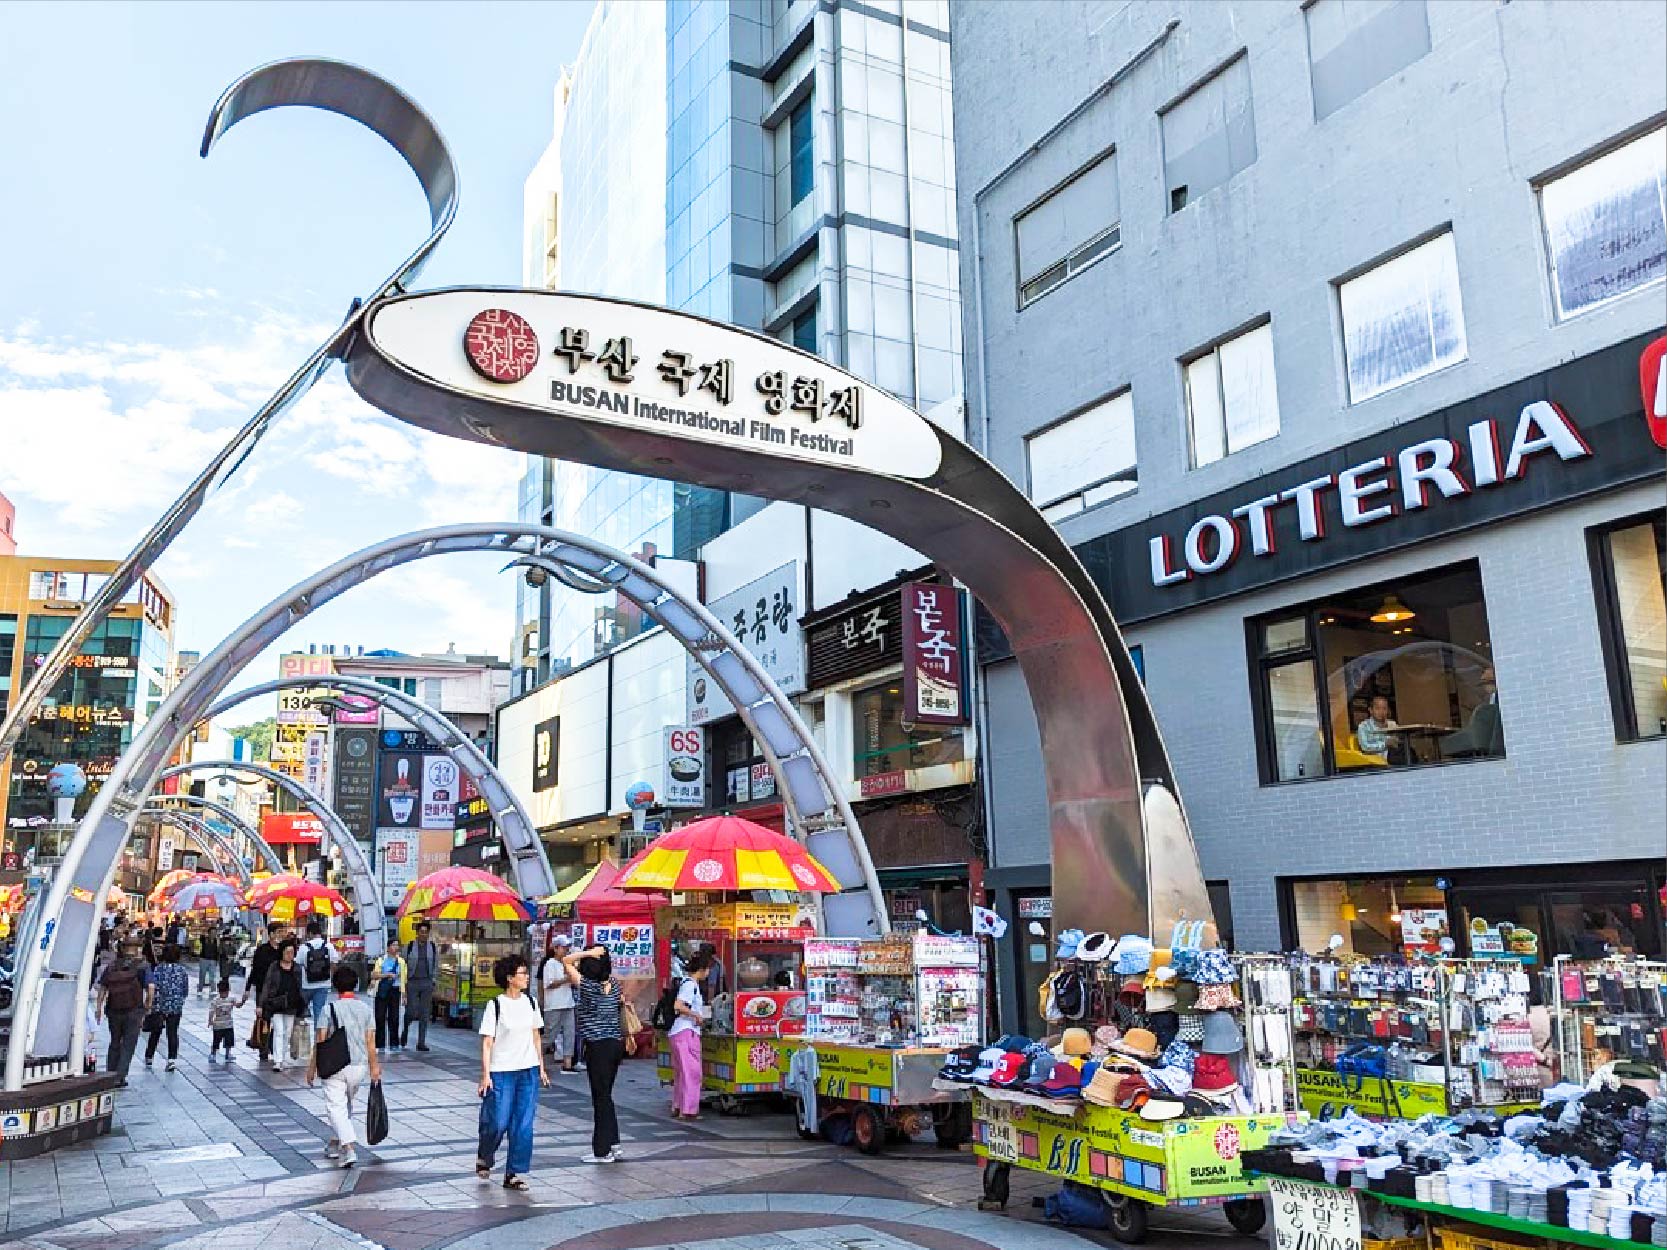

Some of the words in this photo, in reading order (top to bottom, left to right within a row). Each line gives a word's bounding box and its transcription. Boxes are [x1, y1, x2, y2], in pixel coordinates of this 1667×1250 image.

[554, 326, 639, 384] 부산
[656, 348, 735, 406] 국제
[756, 370, 865, 431] 영화제
[551, 380, 629, 415] BUSAN
[633, 396, 747, 438] International
[749, 420, 787, 447] Film
[790, 427, 854, 457] Festival
[1149, 400, 1594, 588] LOTTERIA
[719, 585, 793, 646] 주곰탕
[913, 590, 957, 674] 본죽
[1296, 1073, 1341, 1089] BUSAN
[1190, 1165, 1227, 1177] BUSAN
